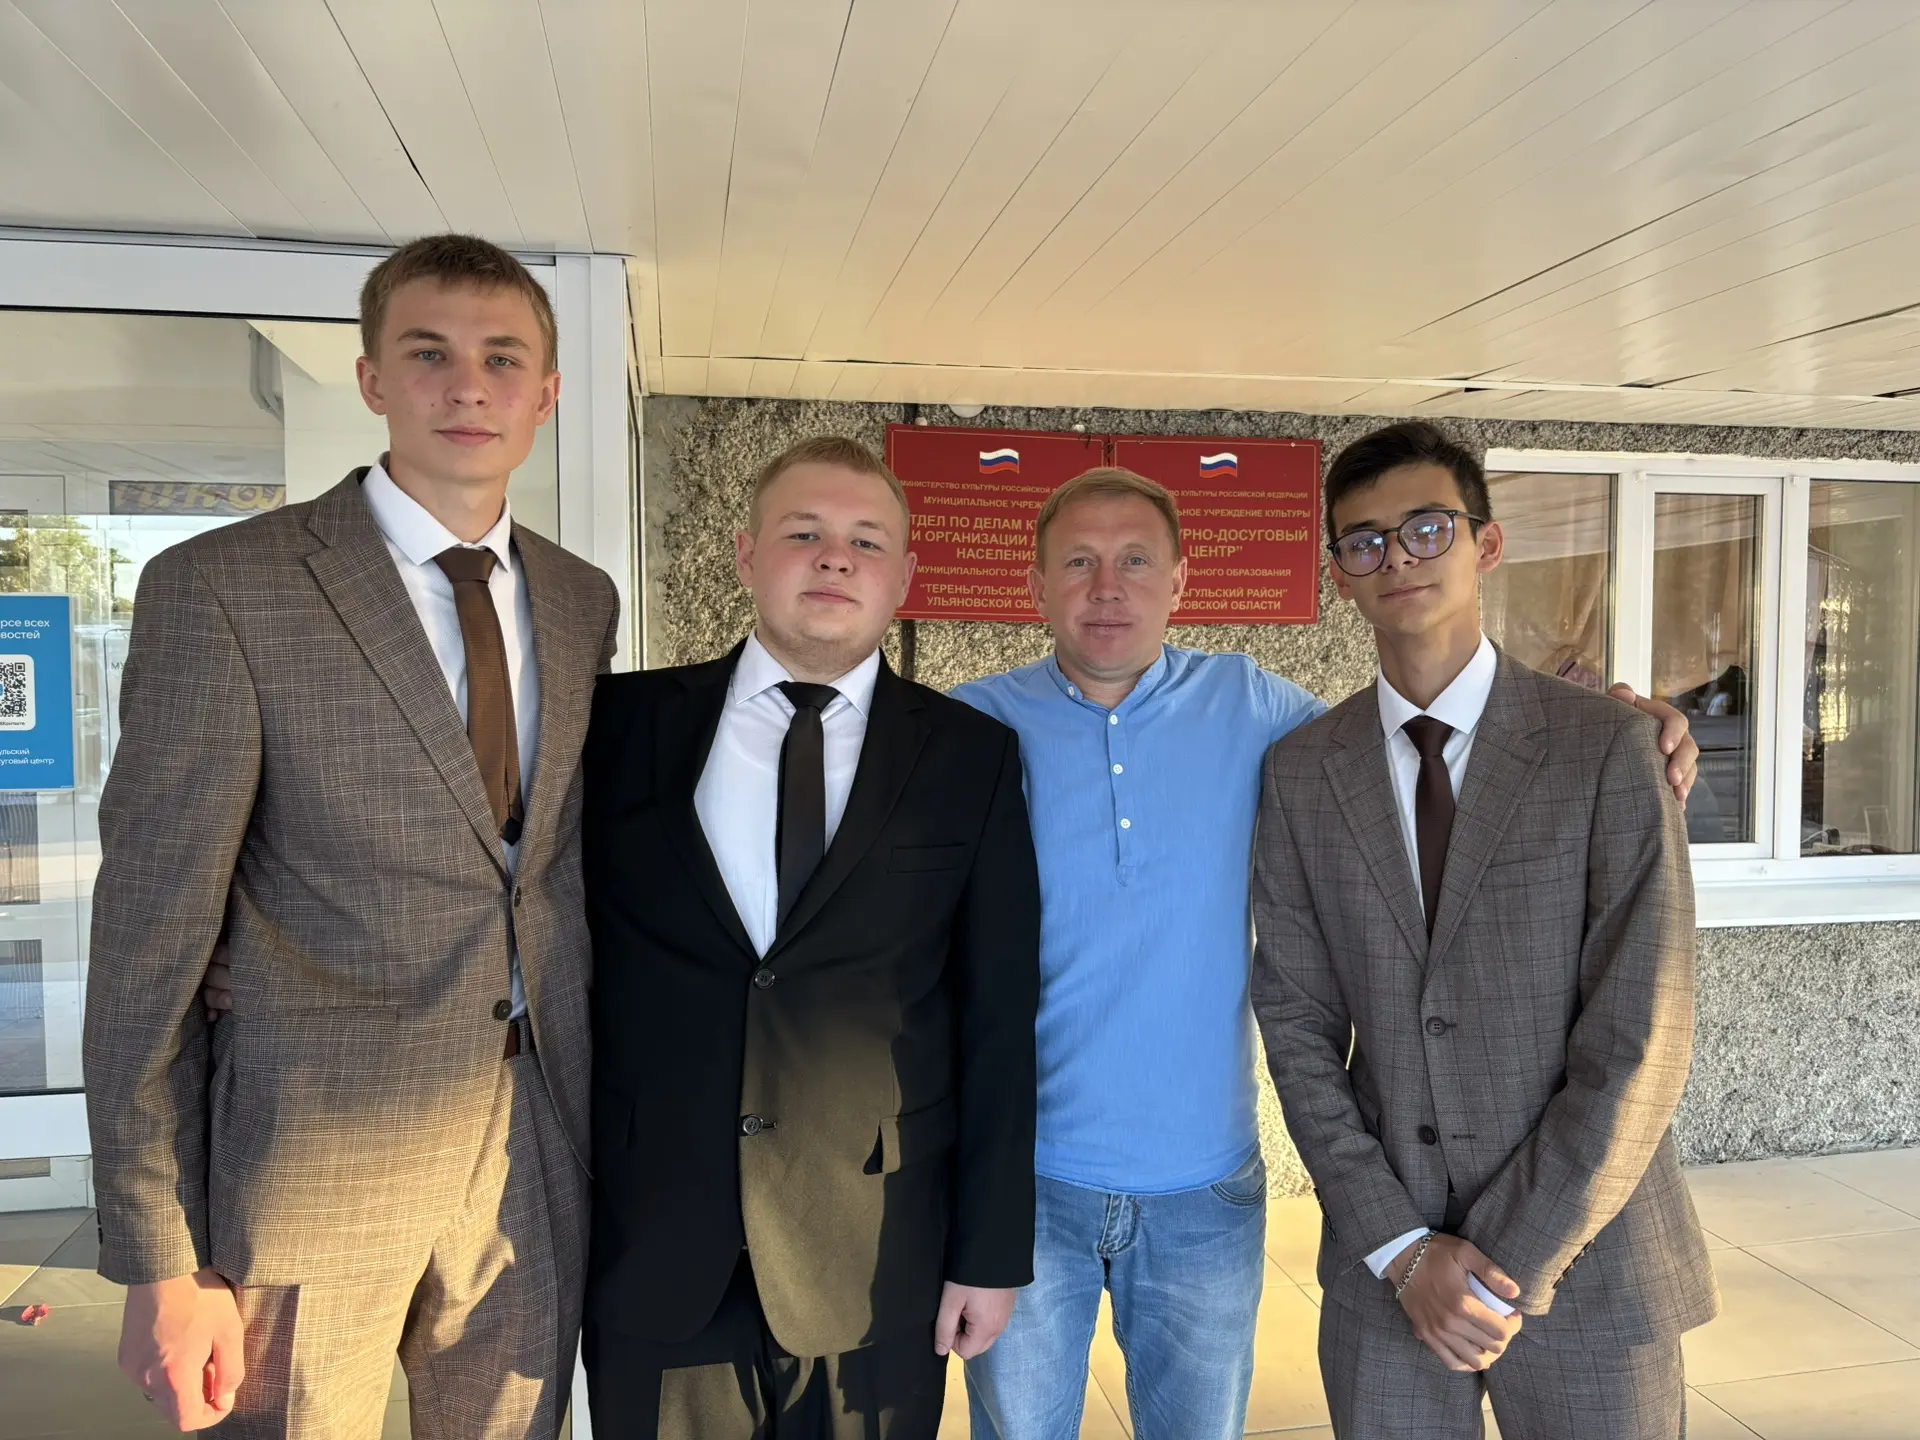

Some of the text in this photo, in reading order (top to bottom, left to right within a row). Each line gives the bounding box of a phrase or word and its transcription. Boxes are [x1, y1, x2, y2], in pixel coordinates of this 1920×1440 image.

[1001, 485, 1050, 493] РОССИЙСКОЙ
[1218, 490, 1265, 498] РОССИЙСКОЙ
[1266, 491, 1308, 499] ФЕДЕРАЦИИ
[924, 496, 1044, 509] МУНИЦИПАЛЬНОЕ УЧРЕЖ
[1203, 508, 1262, 518] УЧРЕЖДЕНИЕ
[1264, 509, 1311, 518] КУЛЬТУРЫ
[949, 516, 970, 528] ПО
[973, 517, 1022, 530] ДЕЛАМ
[1026, 519, 1037, 531] К
[911, 530, 921, 541] И
[925, 530, 1028, 547] ОРГАНИЗАЦИИ
[916, 565, 1008, 577] МУНИЦИПАЛЬНОГО
[1186, 568, 1291, 577] ЛЬНОГО ОБРАЗОВАНИЯ
[927, 596, 1012, 609] УЛЬЯНОВСКОЙ
[1230, 600, 1281, 610] ОБЛАСТИ
[0, 619, 50, 629] рсе всех
[0, 629, 41, 639] востей
[30, 759, 55, 767] центр
